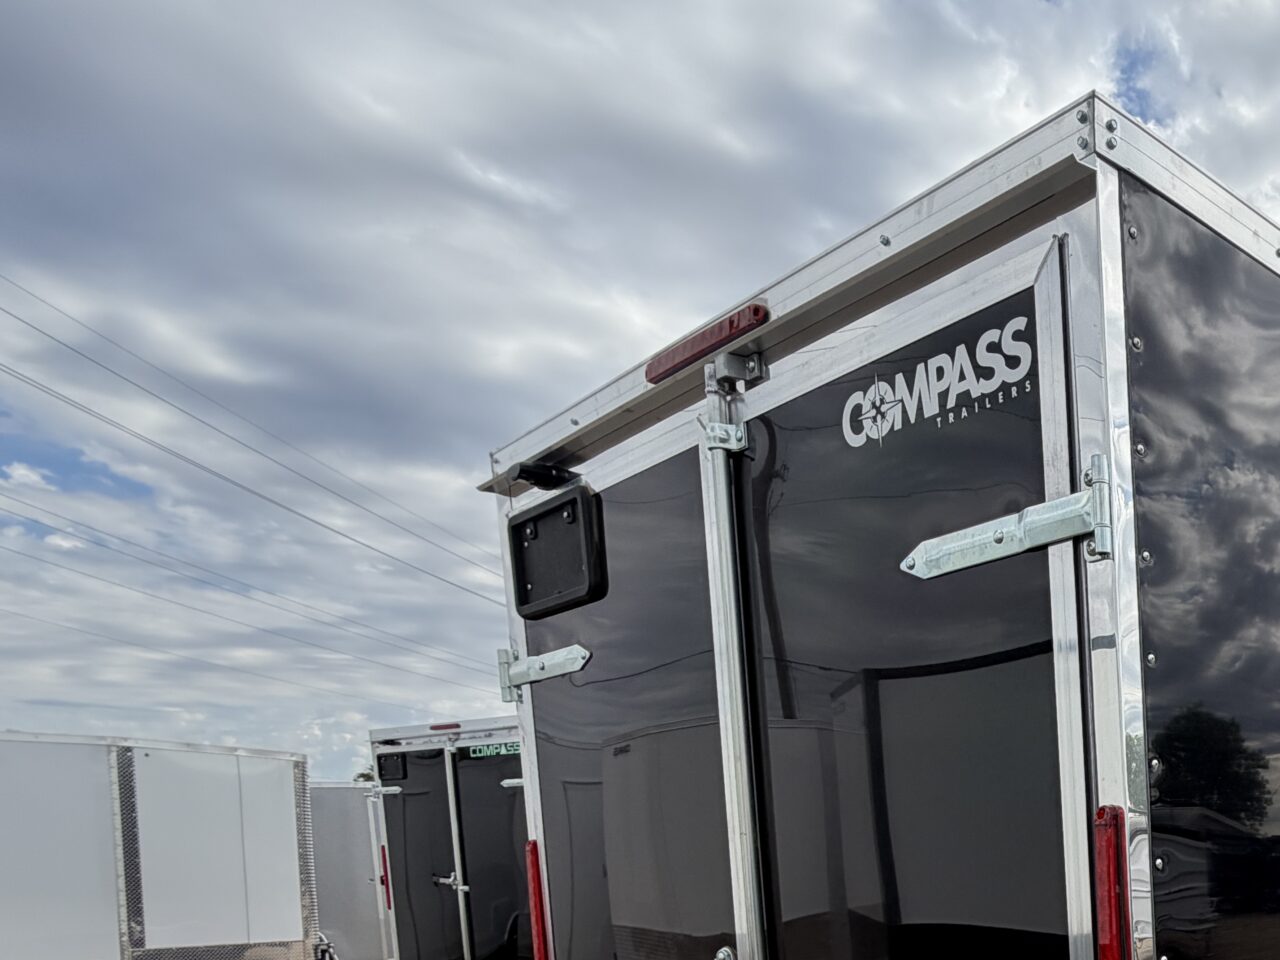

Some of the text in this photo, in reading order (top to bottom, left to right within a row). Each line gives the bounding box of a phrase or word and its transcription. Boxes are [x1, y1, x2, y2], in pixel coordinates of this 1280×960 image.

[842, 316, 1032, 447] COMPASS
[936, 380, 1032, 428] TRAILERS
[470, 742, 521, 757] COMPASS
